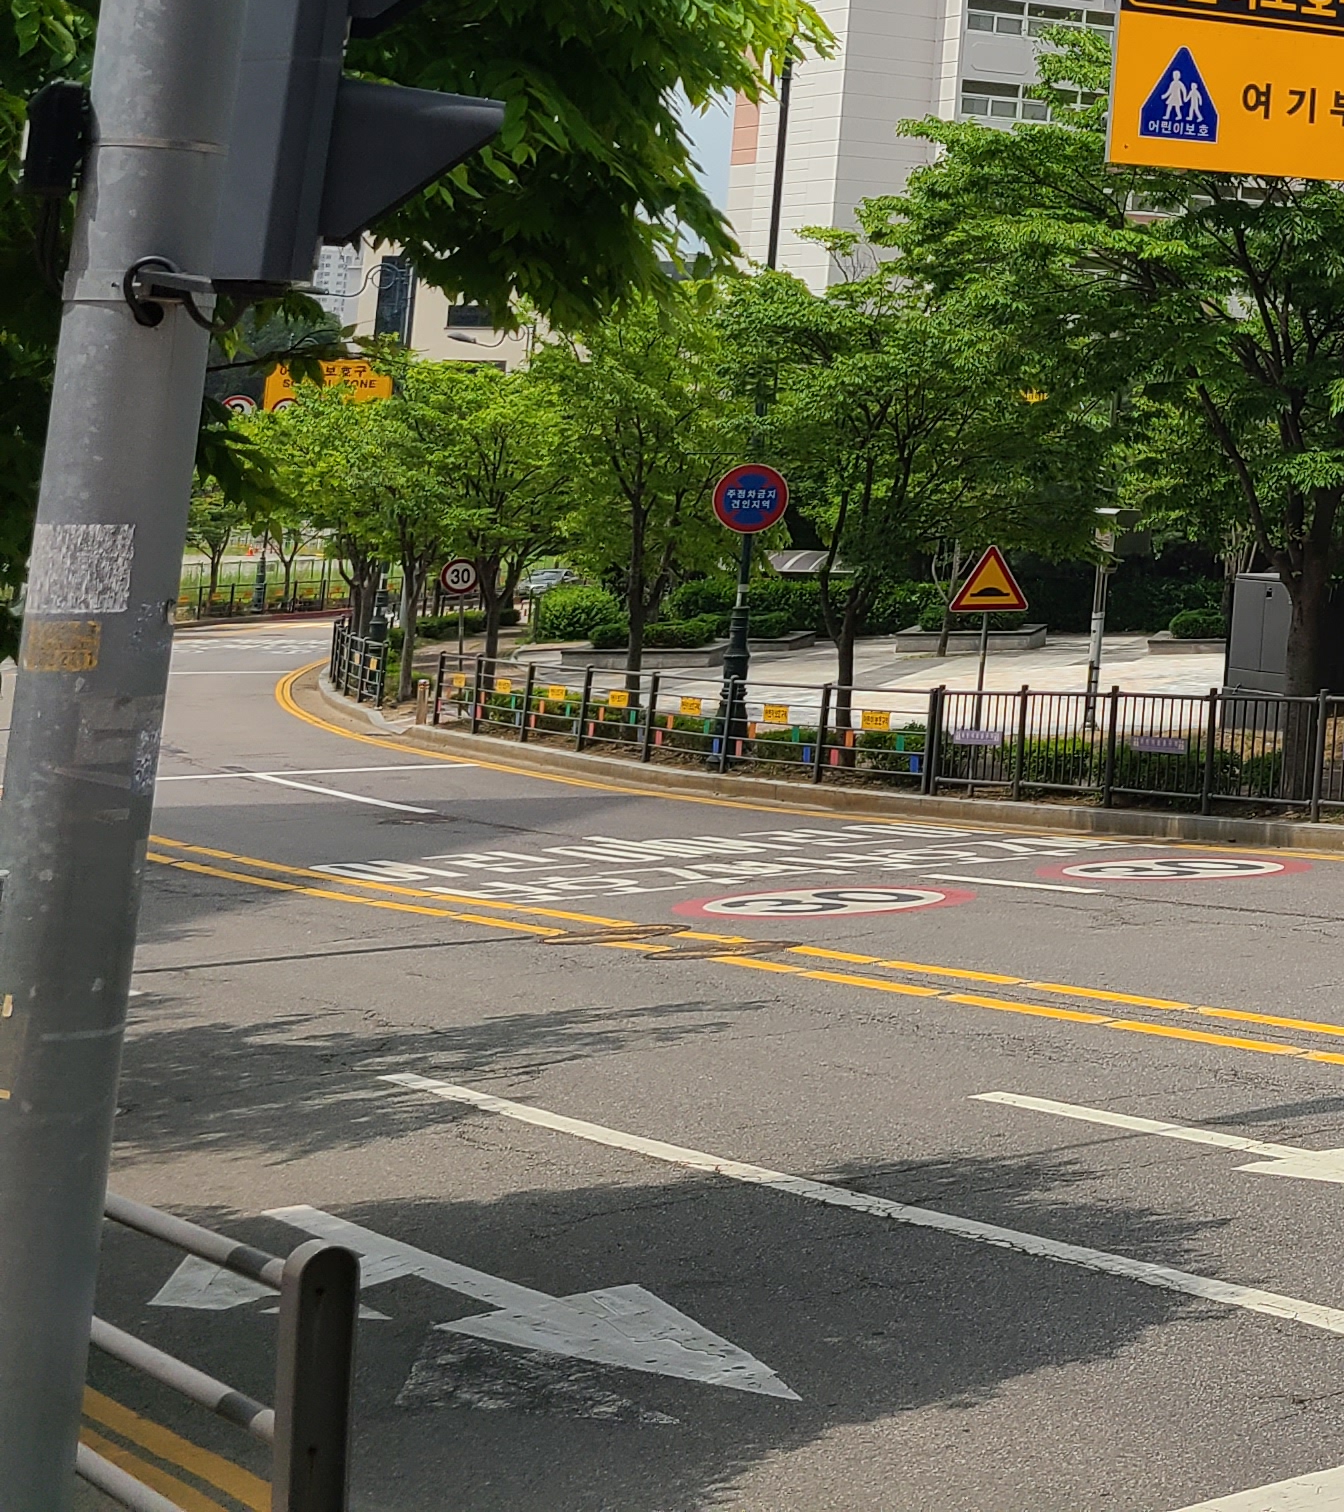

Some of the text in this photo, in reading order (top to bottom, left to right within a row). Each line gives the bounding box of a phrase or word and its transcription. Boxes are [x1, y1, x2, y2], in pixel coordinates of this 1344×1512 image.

[1147, 119, 1210, 138] 어린이보호
[727, 489, 777, 499] 주정차금지
[731, 499, 771, 509] 견인지역
[450, 568, 471, 585] 30
[776, 835, 1173, 871] 보호구역
[1078, 860, 1266, 877] 30
[422, 860, 858, 903] 보호구역
[720, 889, 925, 913] 30
